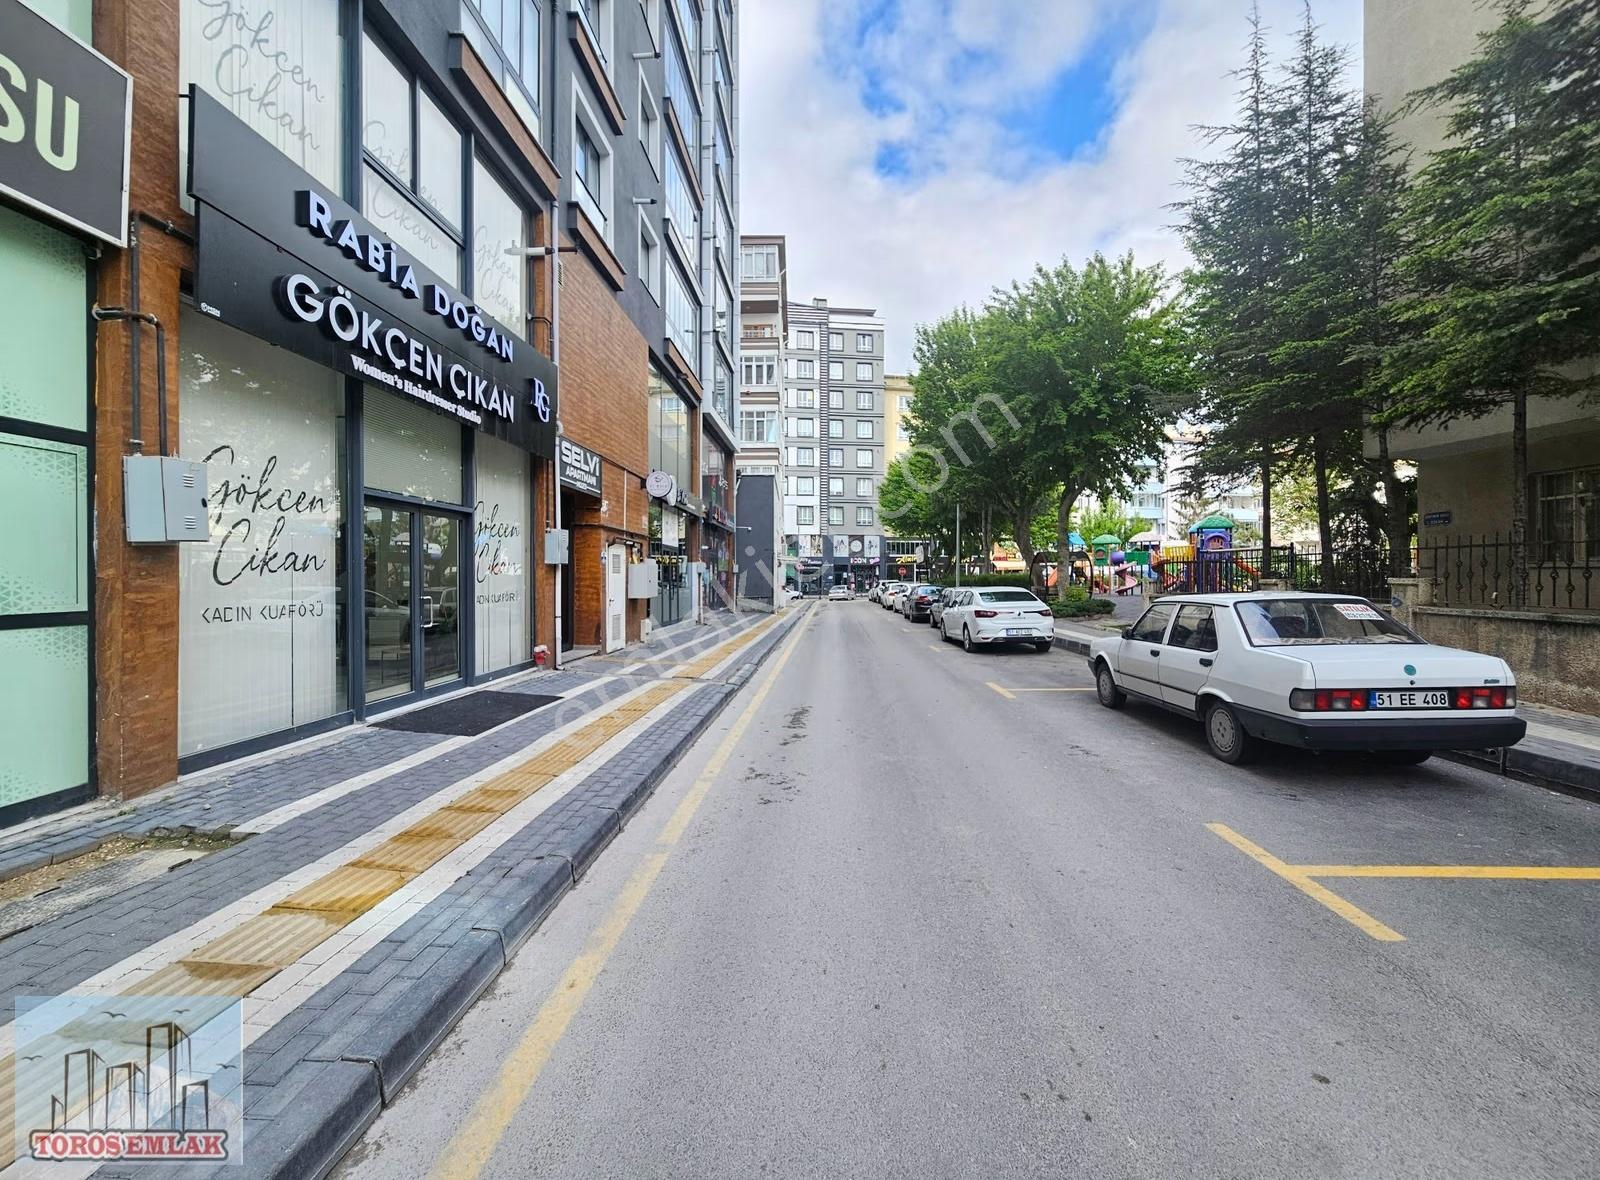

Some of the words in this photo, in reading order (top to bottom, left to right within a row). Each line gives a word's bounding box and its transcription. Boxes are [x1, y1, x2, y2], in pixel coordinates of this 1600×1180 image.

[0, 52, 80, 172] SU
[308, 189, 421, 300] RABİA
[434, 284, 514, 363] DOĞAN
[286, 273, 443, 388] GÖKÇEN
[449, 363, 515, 423] ÇIKAN
[1377, 693, 1393, 706] 51
[1399, 693, 1416, 706] EE
[1422, 693, 1447, 706] 408
